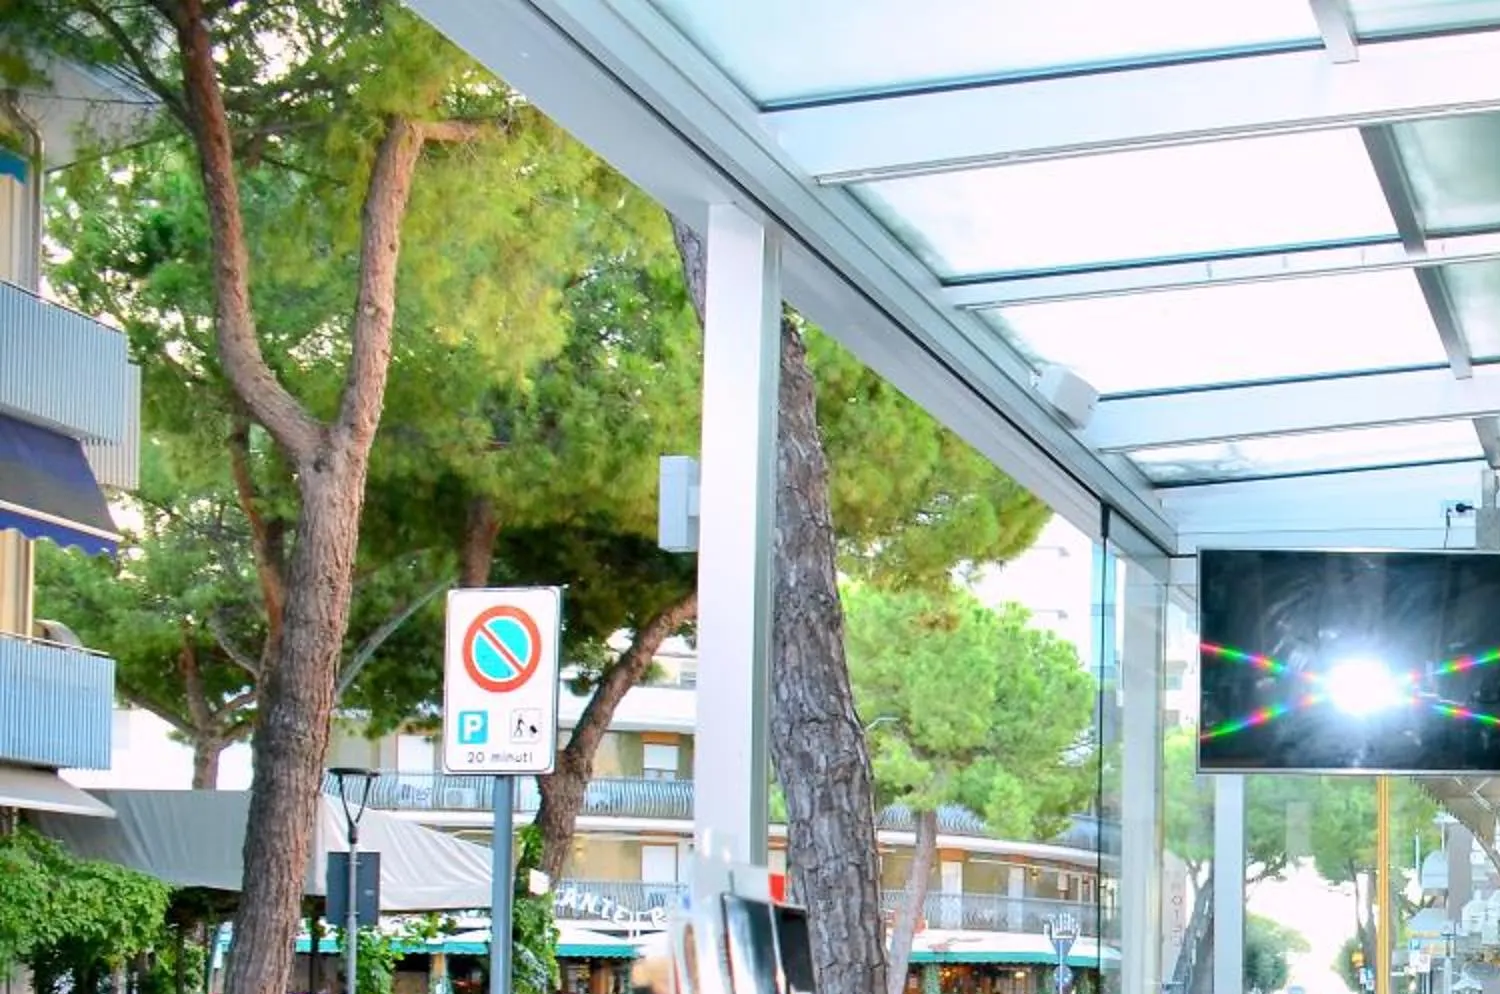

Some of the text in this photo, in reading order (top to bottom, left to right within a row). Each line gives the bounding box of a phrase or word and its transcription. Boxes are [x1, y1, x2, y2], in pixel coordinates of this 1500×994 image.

[463, 713, 482, 741] P
[467, 752, 533, 763] 20 minuti
